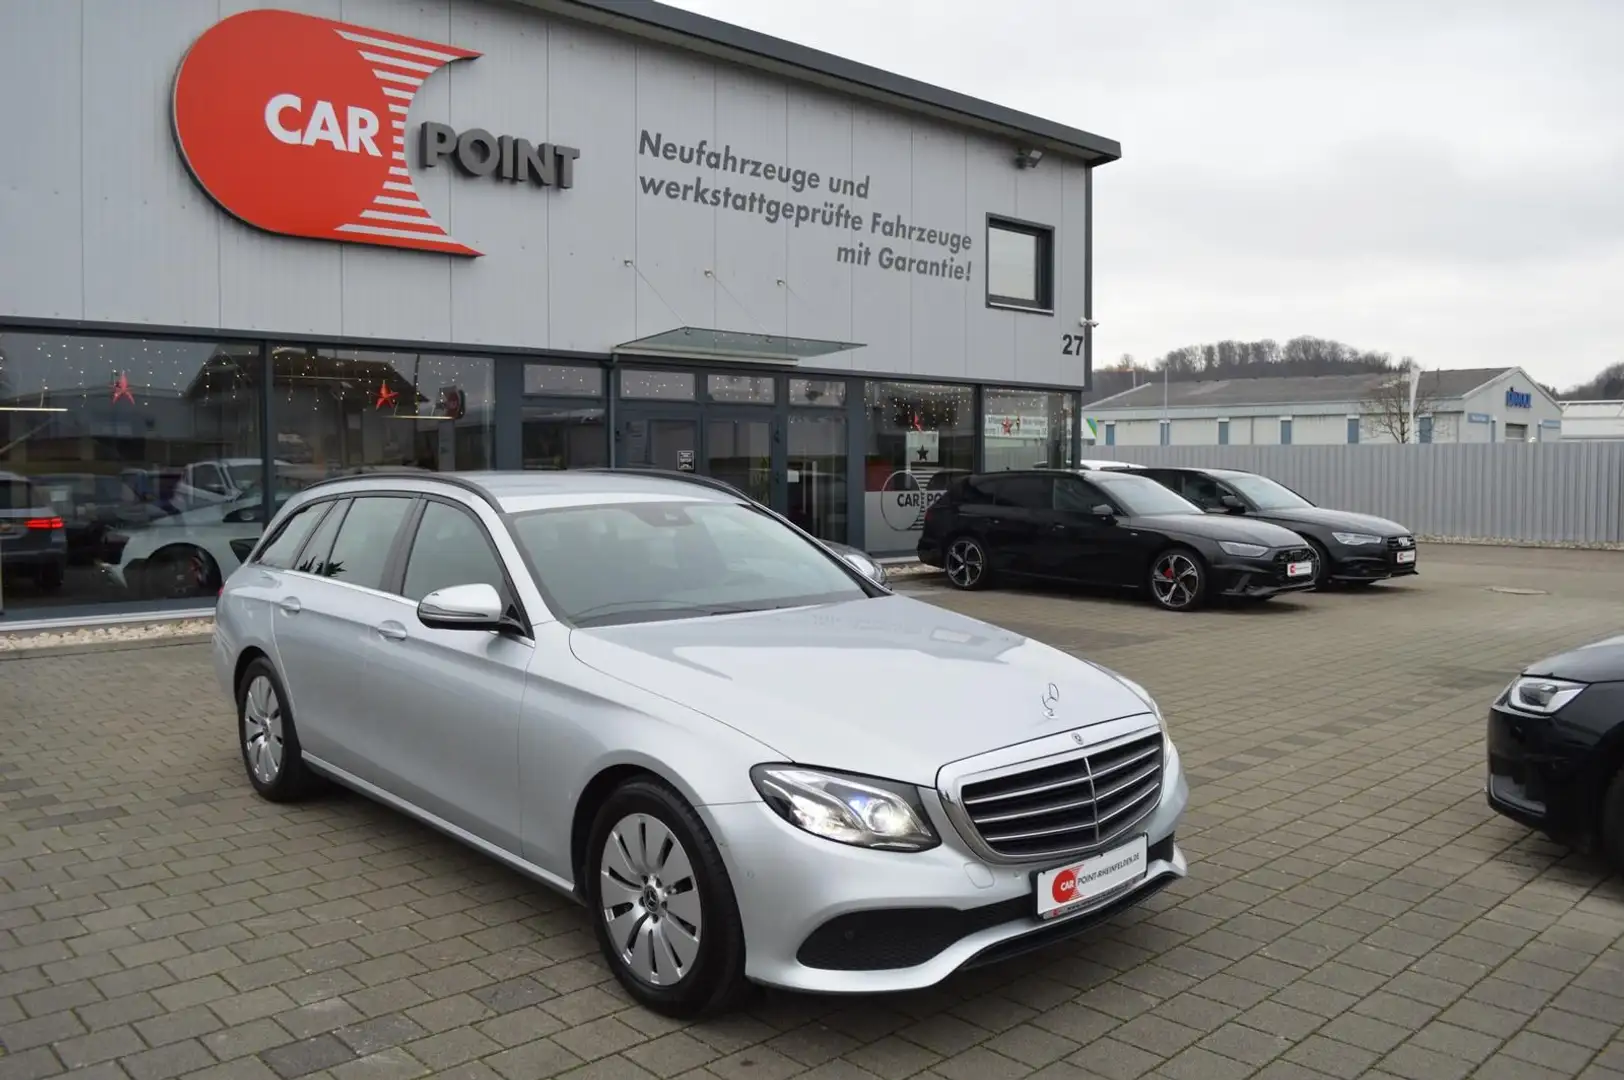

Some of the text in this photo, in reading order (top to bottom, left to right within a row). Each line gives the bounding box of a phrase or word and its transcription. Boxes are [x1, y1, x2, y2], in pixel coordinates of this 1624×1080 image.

[265, 93, 580, 189] CAR POINT
[638, 129, 870, 200] Neufahrzeuge und
[639, 175, 972, 254] werkstattgeprüfte Fahrzeuge
[836, 242, 972, 282] mit Garantie!
[1062, 334, 1083, 356] 27
[897, 493, 920, 507] CAR
[1060, 853, 1140, 892] CAR POINT-RHEINFELDEN.DE
